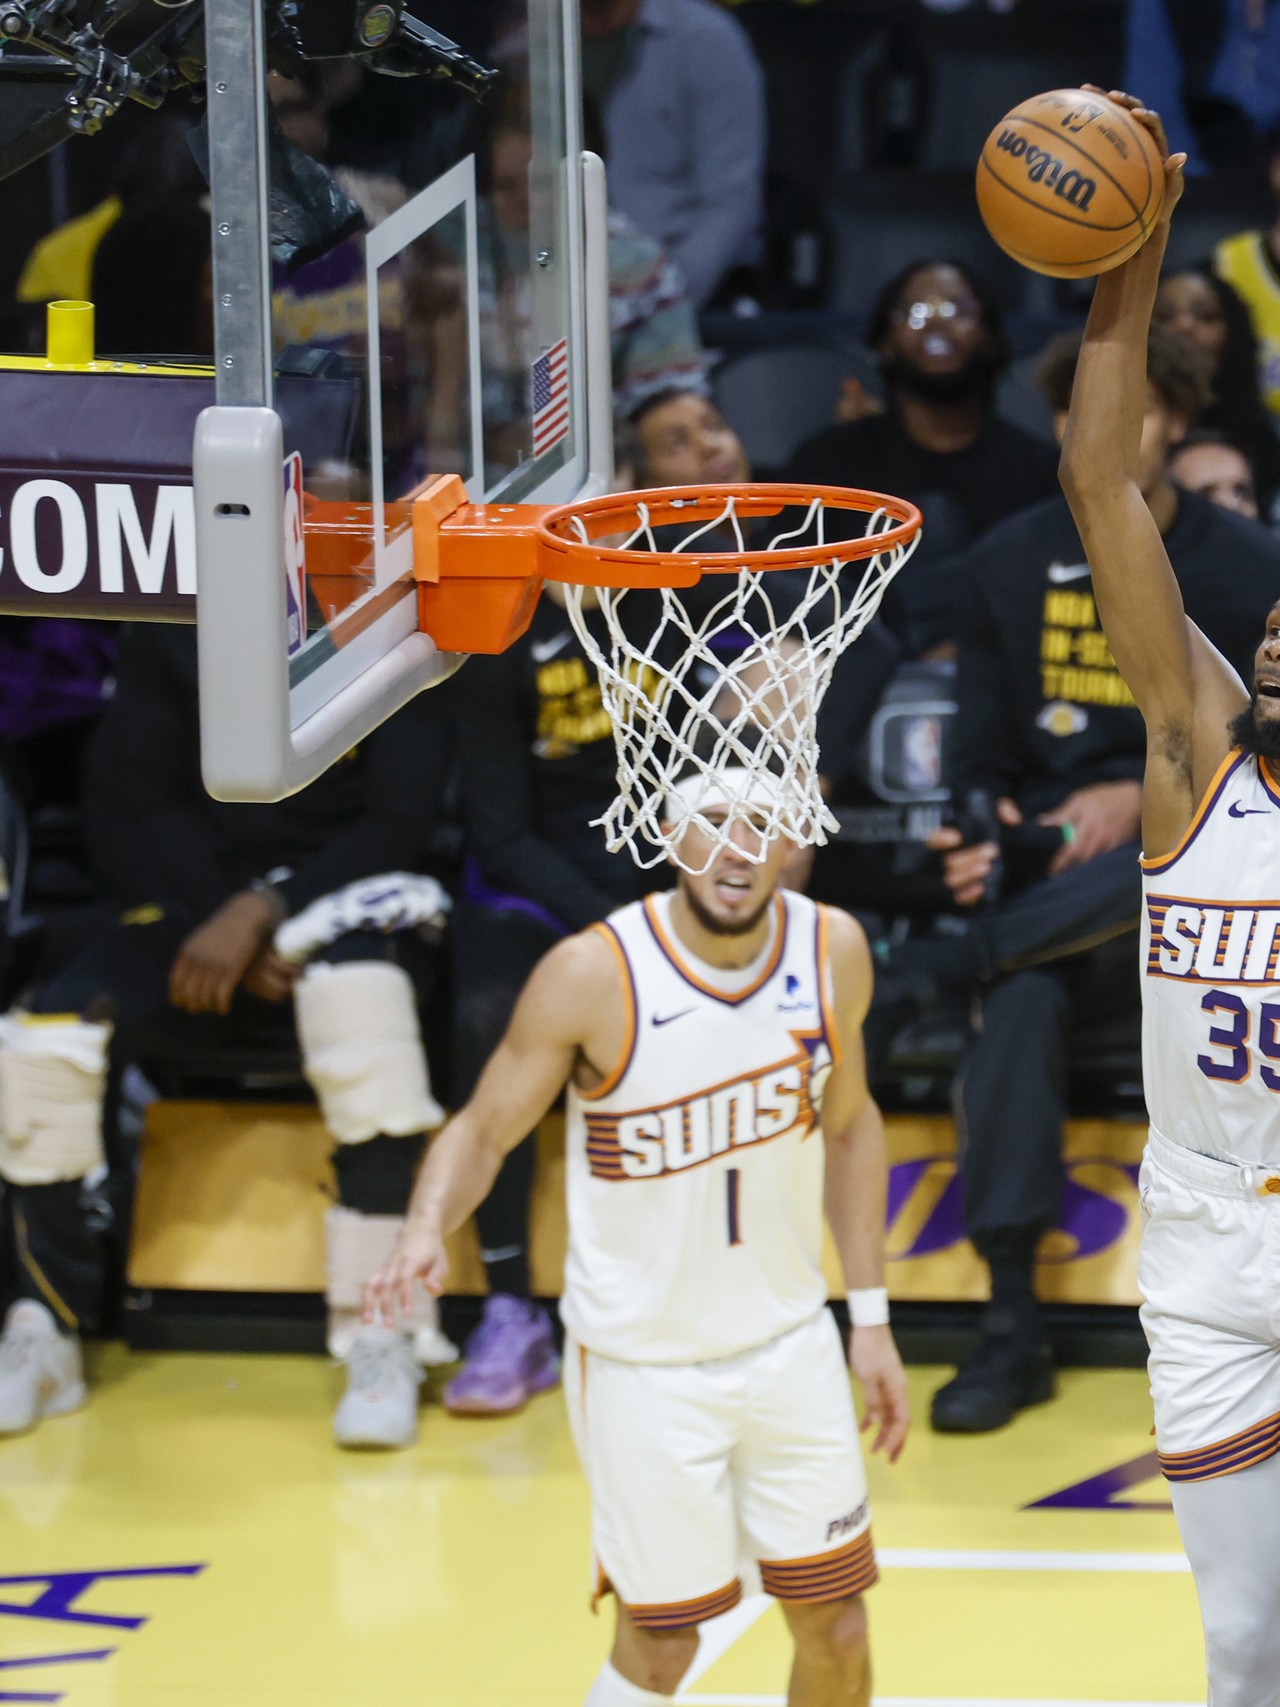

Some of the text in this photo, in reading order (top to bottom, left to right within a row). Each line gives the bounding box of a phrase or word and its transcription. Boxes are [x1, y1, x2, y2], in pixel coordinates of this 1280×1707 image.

[997, 128, 1097, 213] Wilson
[0, 478, 198, 595] OM
[617, 1063, 801, 1179] SUNS
[726, 1168, 743, 1246] 1
